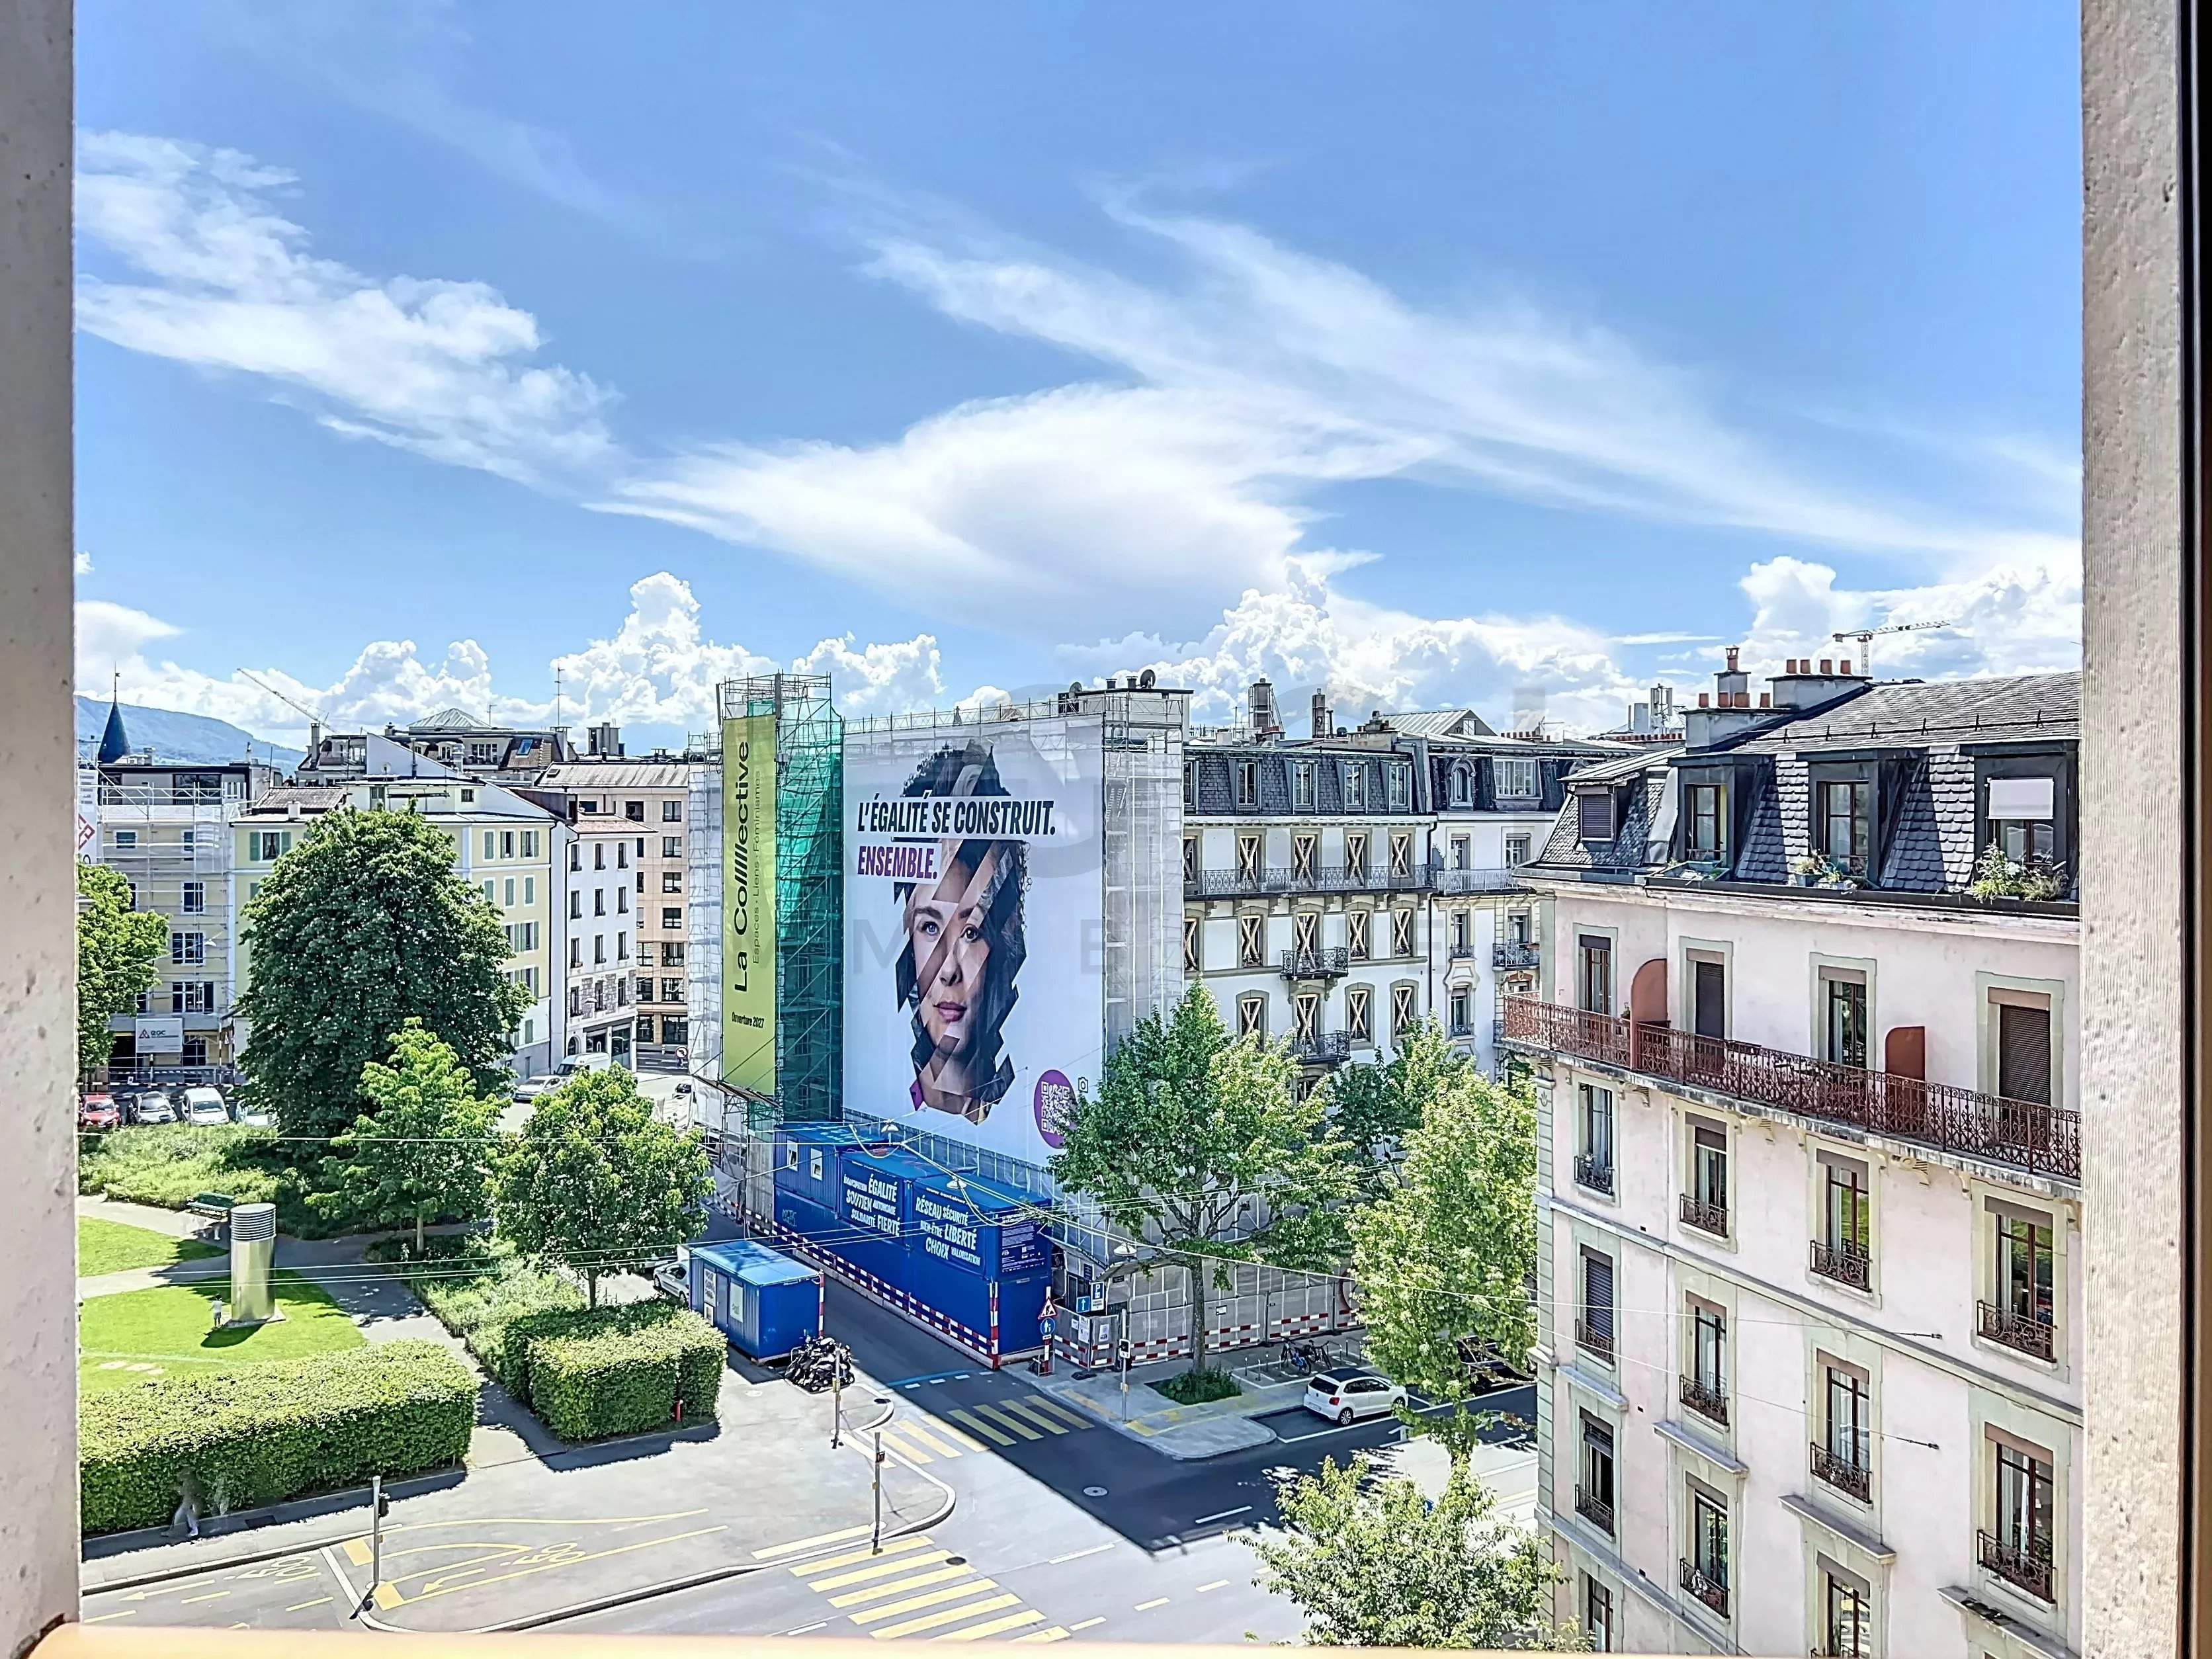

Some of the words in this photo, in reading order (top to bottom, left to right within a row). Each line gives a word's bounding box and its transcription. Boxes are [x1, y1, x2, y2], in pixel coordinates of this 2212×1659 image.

[857, 791, 929, 833] L'ÉGALITÉ
[931, 801, 951, 833] SE
[954, 800, 1056, 835] CONSTRUIT.
[857, 846, 937, 880] ENSEMBLE.
[752, 907, 761, 964] Espaces
[734, 951, 747, 992] La
[732, 1011, 752, 1026] Ouverture
[753, 1016, 765, 1029] 2027
[846, 1189, 872, 1212] SOUTIEN
[872, 1199, 896, 1216] AUTONOMIE
[868, 1173, 898, 1203] ÉGALITÉ
[851, 1209, 876, 1227] SOLIDARITÉ
[877, 1214, 900, 1236] FIERTÉ
[915, 1195, 942, 1220] RÉSEAU
[943, 1205, 968, 1226] SÉCURITÉ
[920, 1220, 943, 1238] BIEN-ÊTRE
[944, 1223, 977, 1250] LIBERTÉ
[925, 1237, 949, 1260] CHOIX
[951, 1246, 981, 1266] VALORISATION
[1095, 1284, 1101, 1293] P
